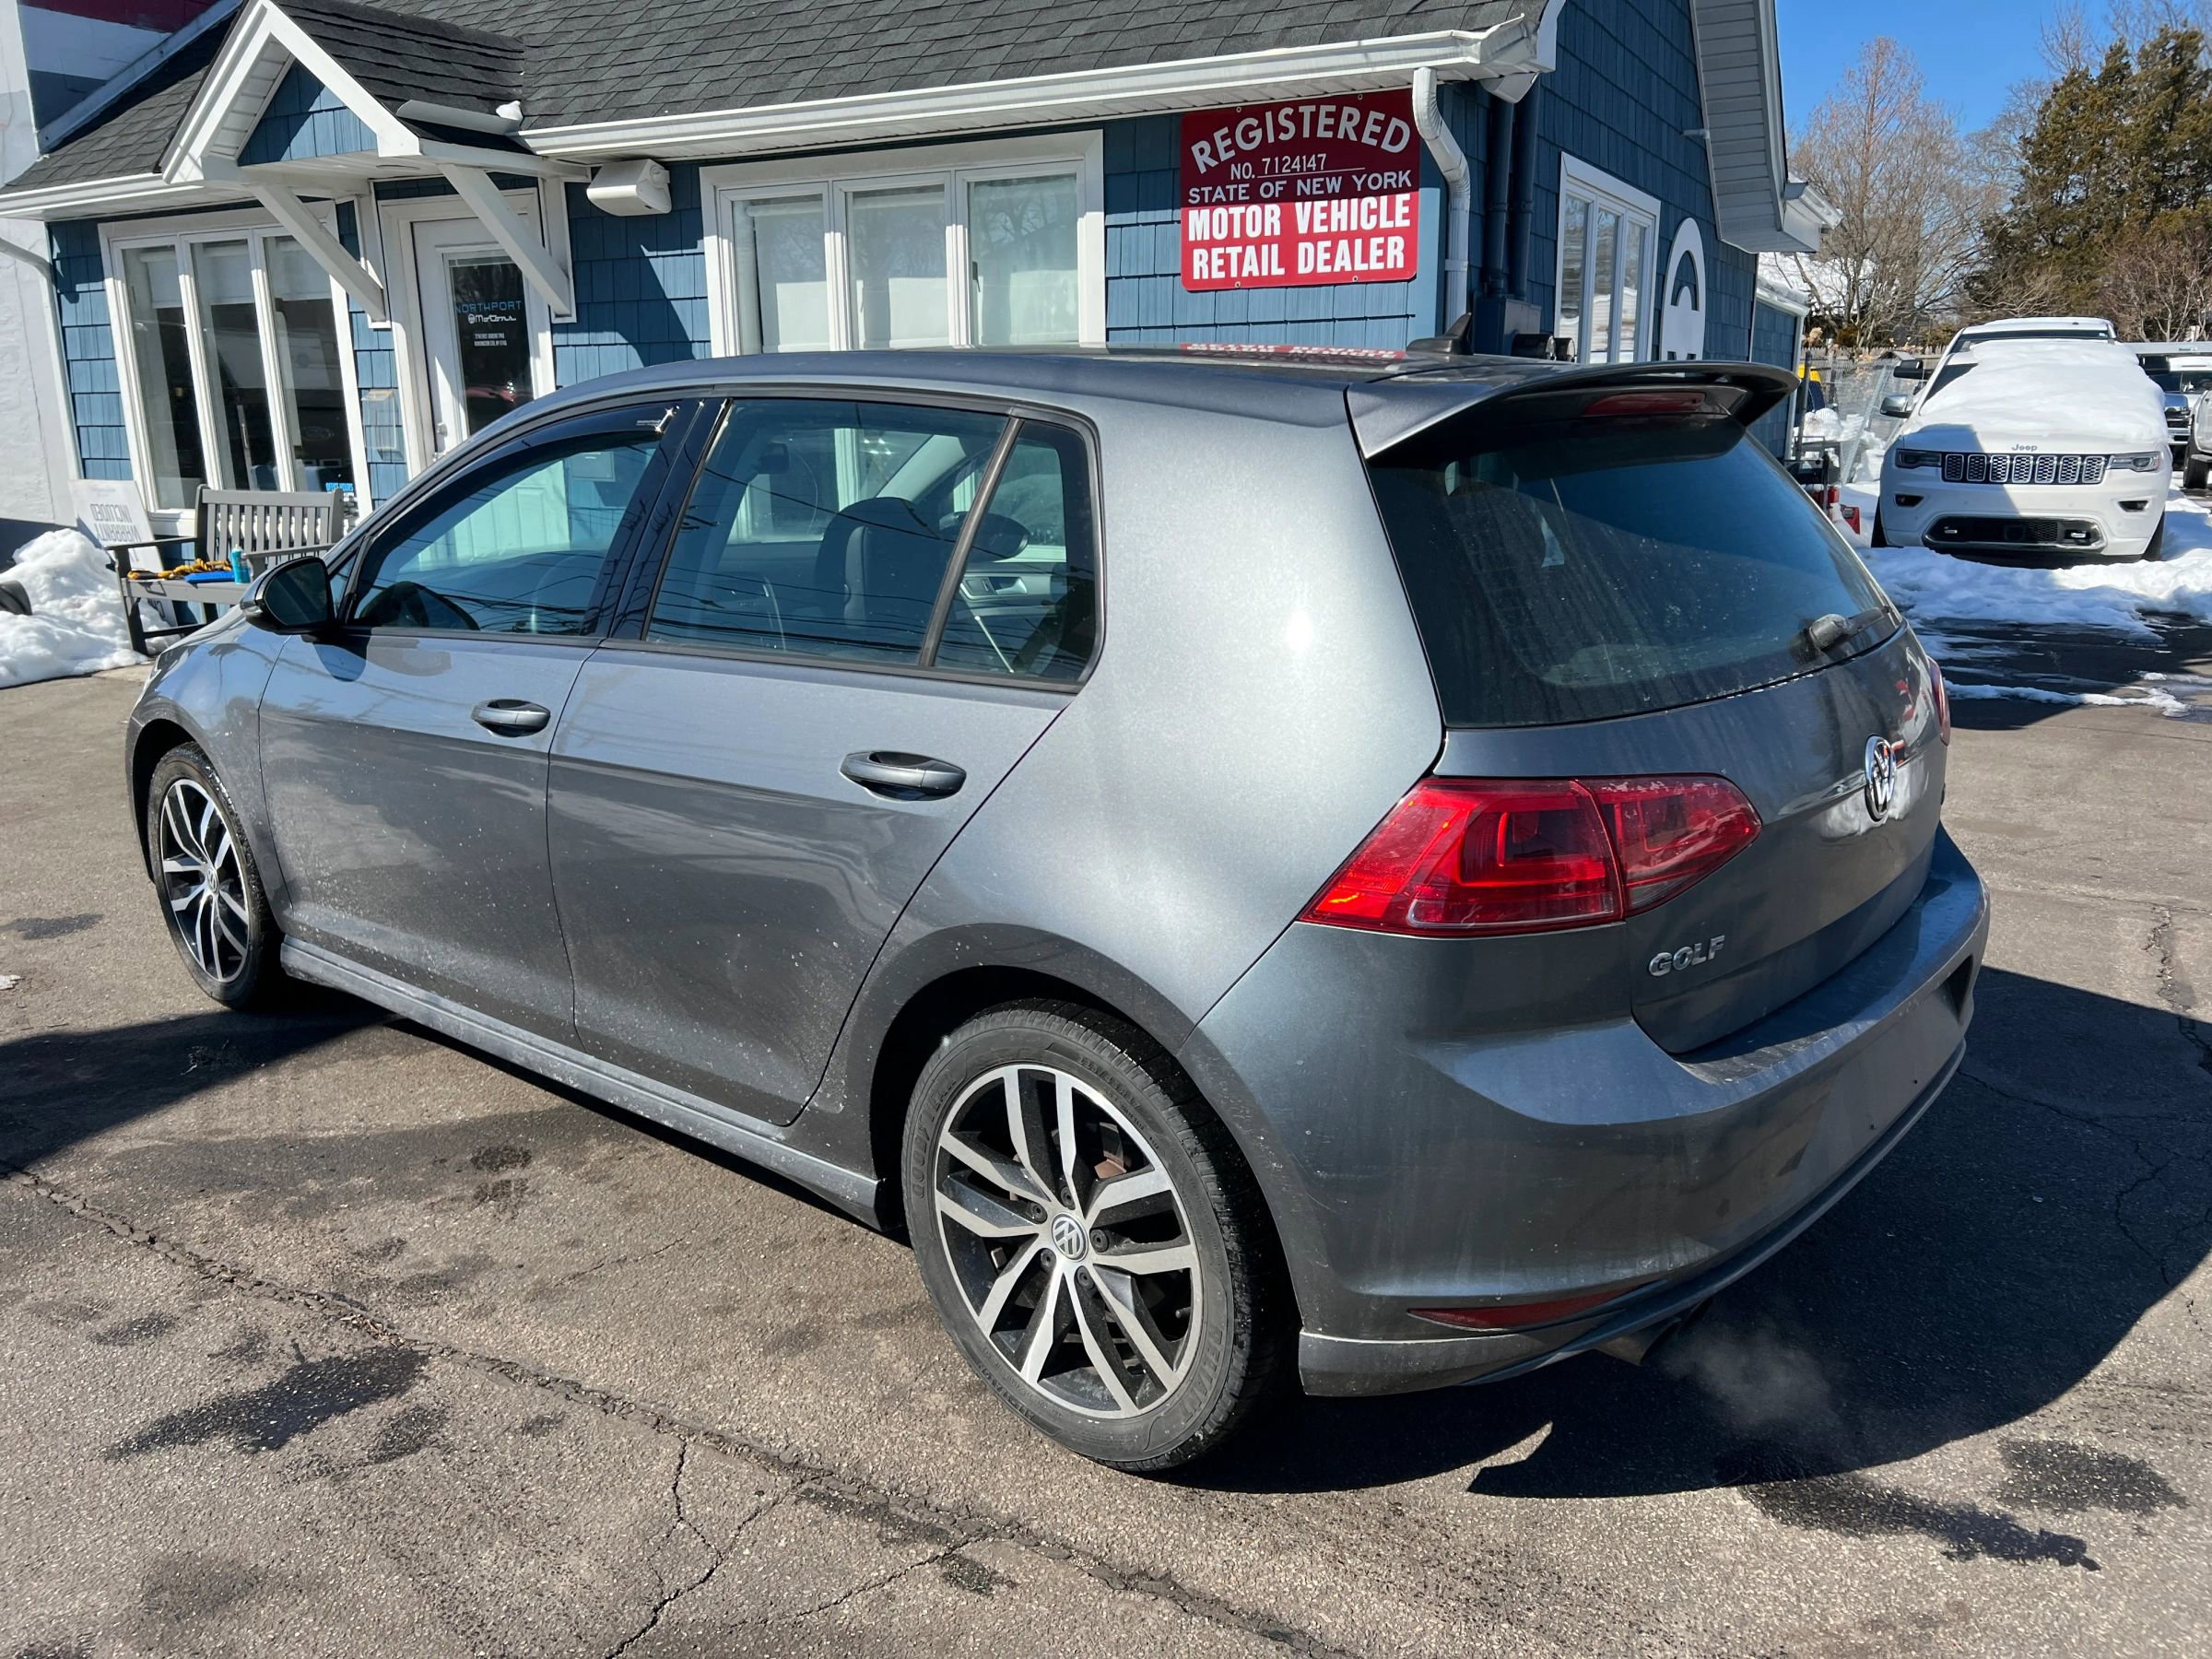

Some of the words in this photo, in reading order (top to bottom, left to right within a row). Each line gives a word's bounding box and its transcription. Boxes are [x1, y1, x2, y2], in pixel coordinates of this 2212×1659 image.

[1191, 104, 1411, 174] REGISTERED
[1230, 162, 1255, 180] NO.
[1262, 153, 1327, 174] 7124147
[1188, 183, 1250, 204] STATE
[1259, 181, 1287, 198] OF
[1297, 176, 1342, 195] NEW
[1352, 170, 1412, 192] YORK
[1188, 204, 1281, 241] MOTOR
[1294, 194, 1411, 234] VEHICLE
[1193, 243, 1285, 279] RETAIL
[1298, 236, 1405, 275] DEALER
[455, 300, 522, 313] NORTHPORT
[2011, 443, 2038, 452] Jeep
[1649, 935, 1725, 977] GOLF
